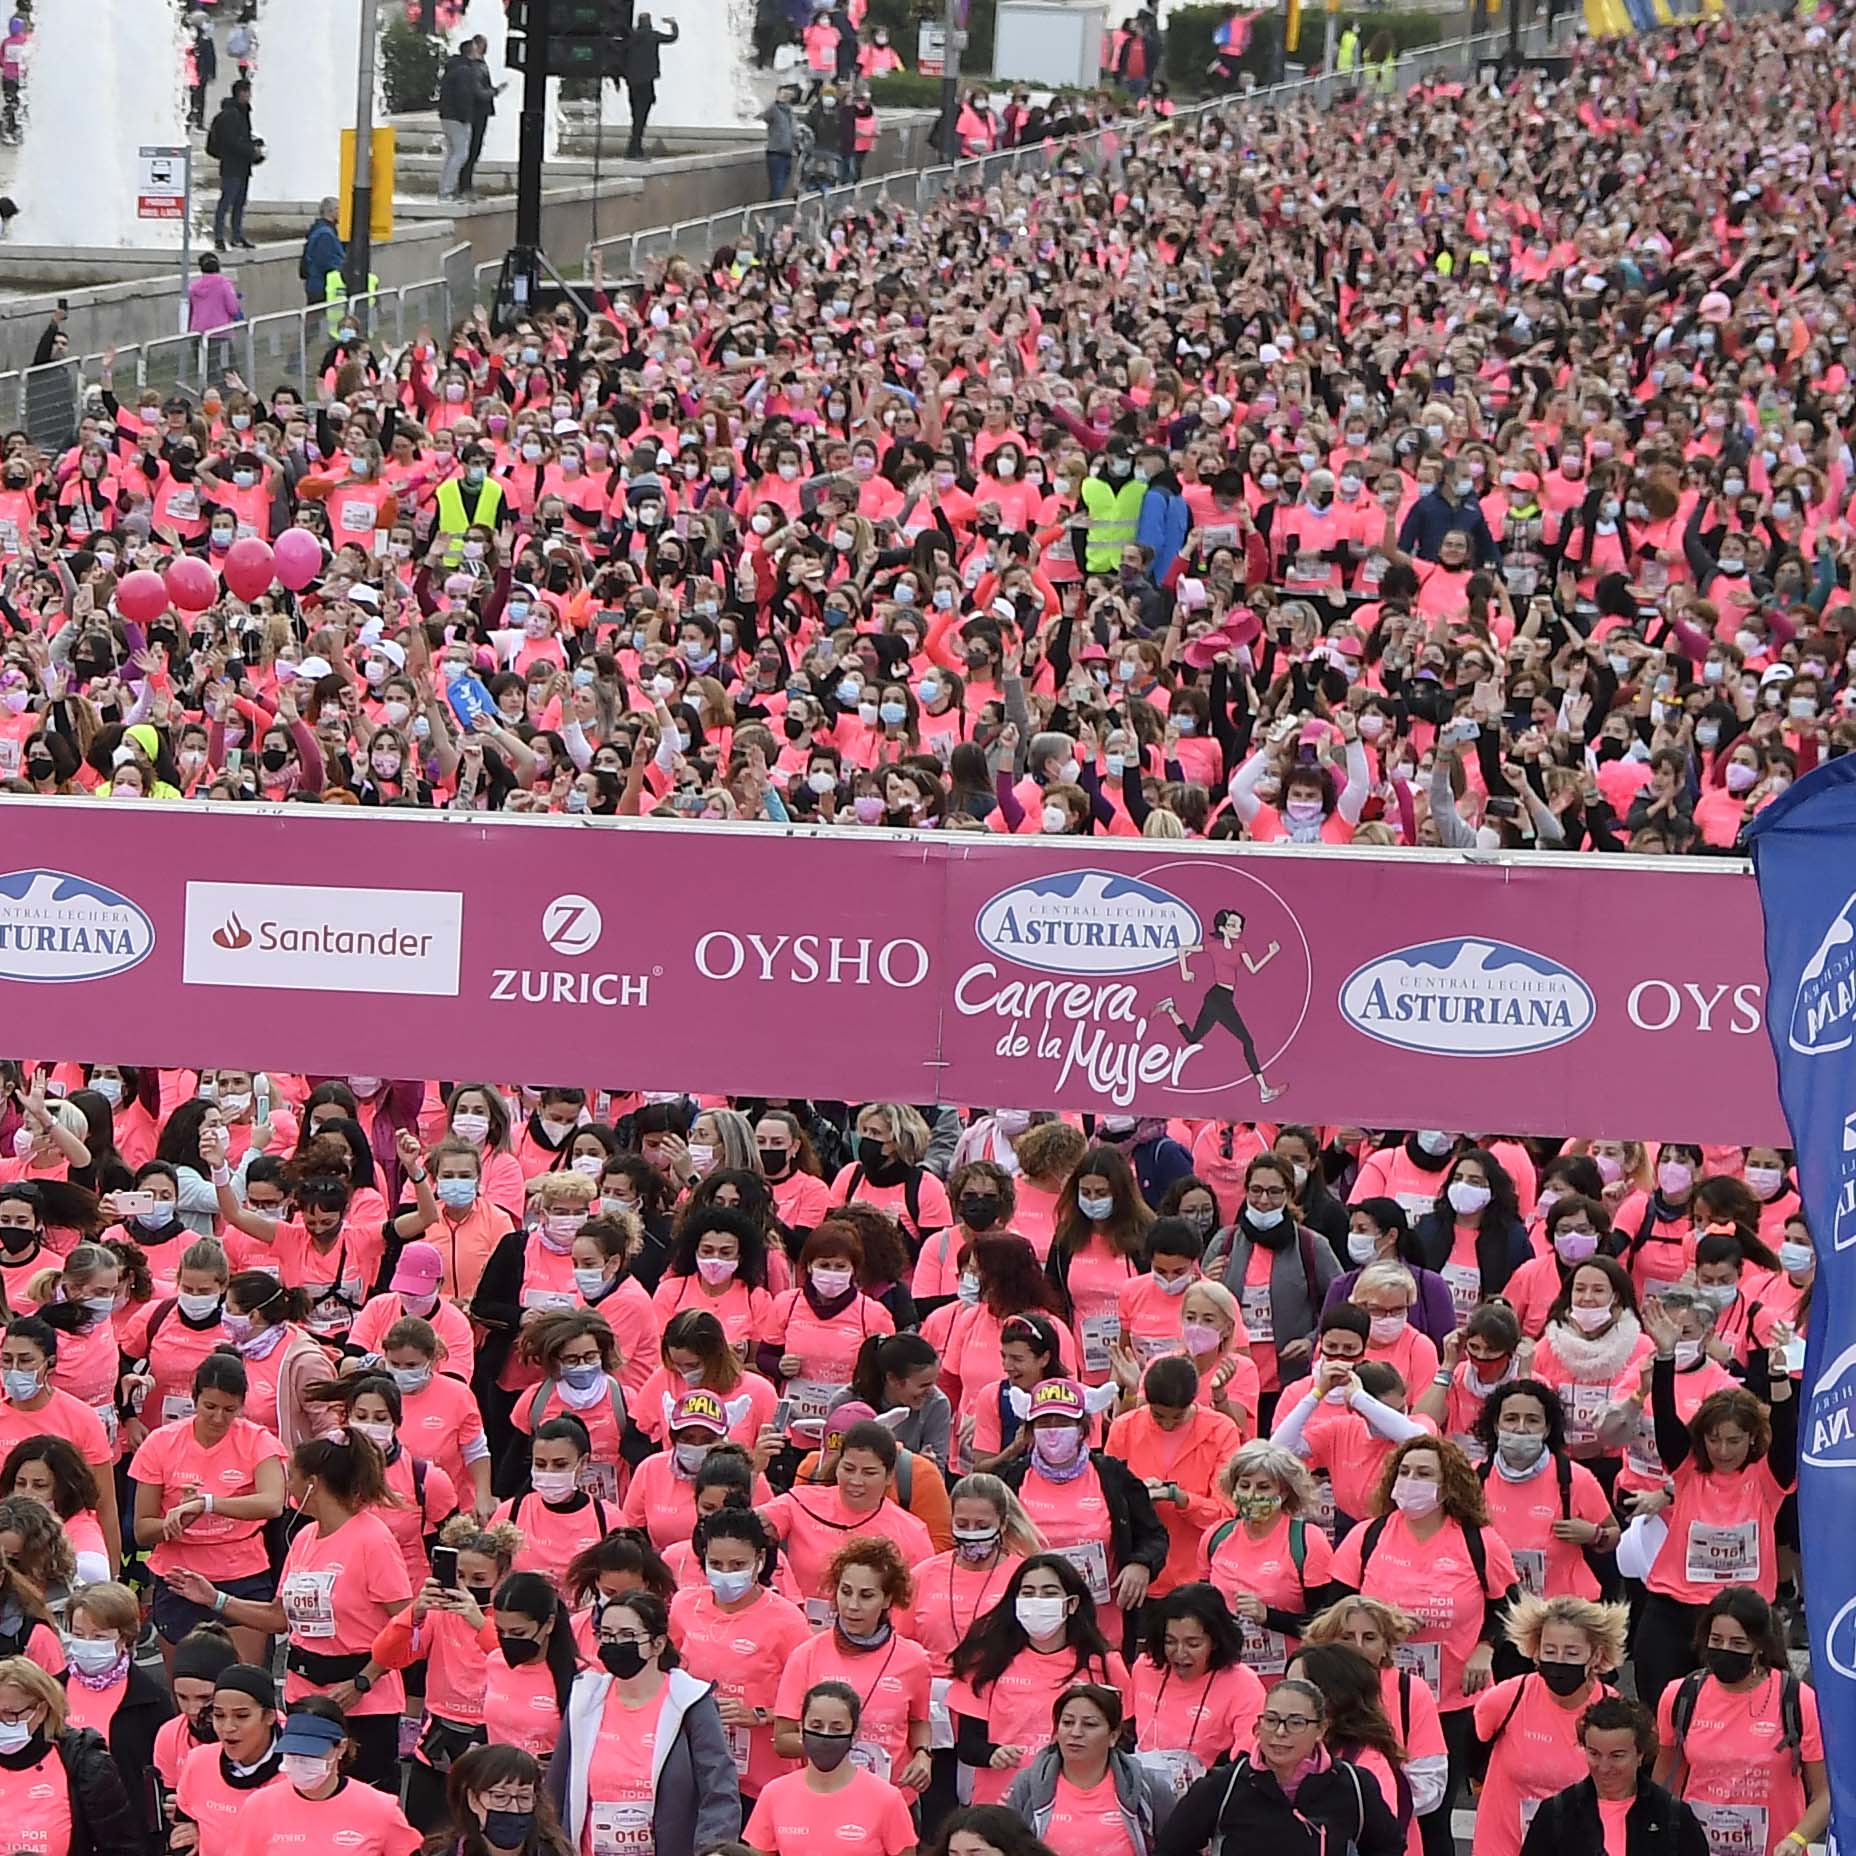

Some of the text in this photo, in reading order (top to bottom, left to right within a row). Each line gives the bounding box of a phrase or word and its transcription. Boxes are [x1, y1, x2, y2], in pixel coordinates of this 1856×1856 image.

[56, 909, 129, 924] LECHERA
[1029, 905, 1178, 923] CENTRAL LECHERA
[259, 921, 432, 961] Santander
[994, 909, 1182, 952] ASTURIANA
[693, 930, 929, 989] OYSHO
[490, 968, 648, 1006] ZURICH
[953, 960, 1139, 1023] Carrera
[1398, 975, 1569, 996] CENTRAL LECHERA
[1357, 976, 1574, 1030] ASTURIANA
[1626, 978, 1762, 1034] OYS
[996, 1020, 1203, 1108] de la Mujer
[294, 1597, 313, 1609] 016
[1427, 1596, 1455, 1607] POR
[20, 1830, 47, 1842] POR
[616, 1830, 648, 1843] 016
[1711, 1830, 1742, 1843] 016
